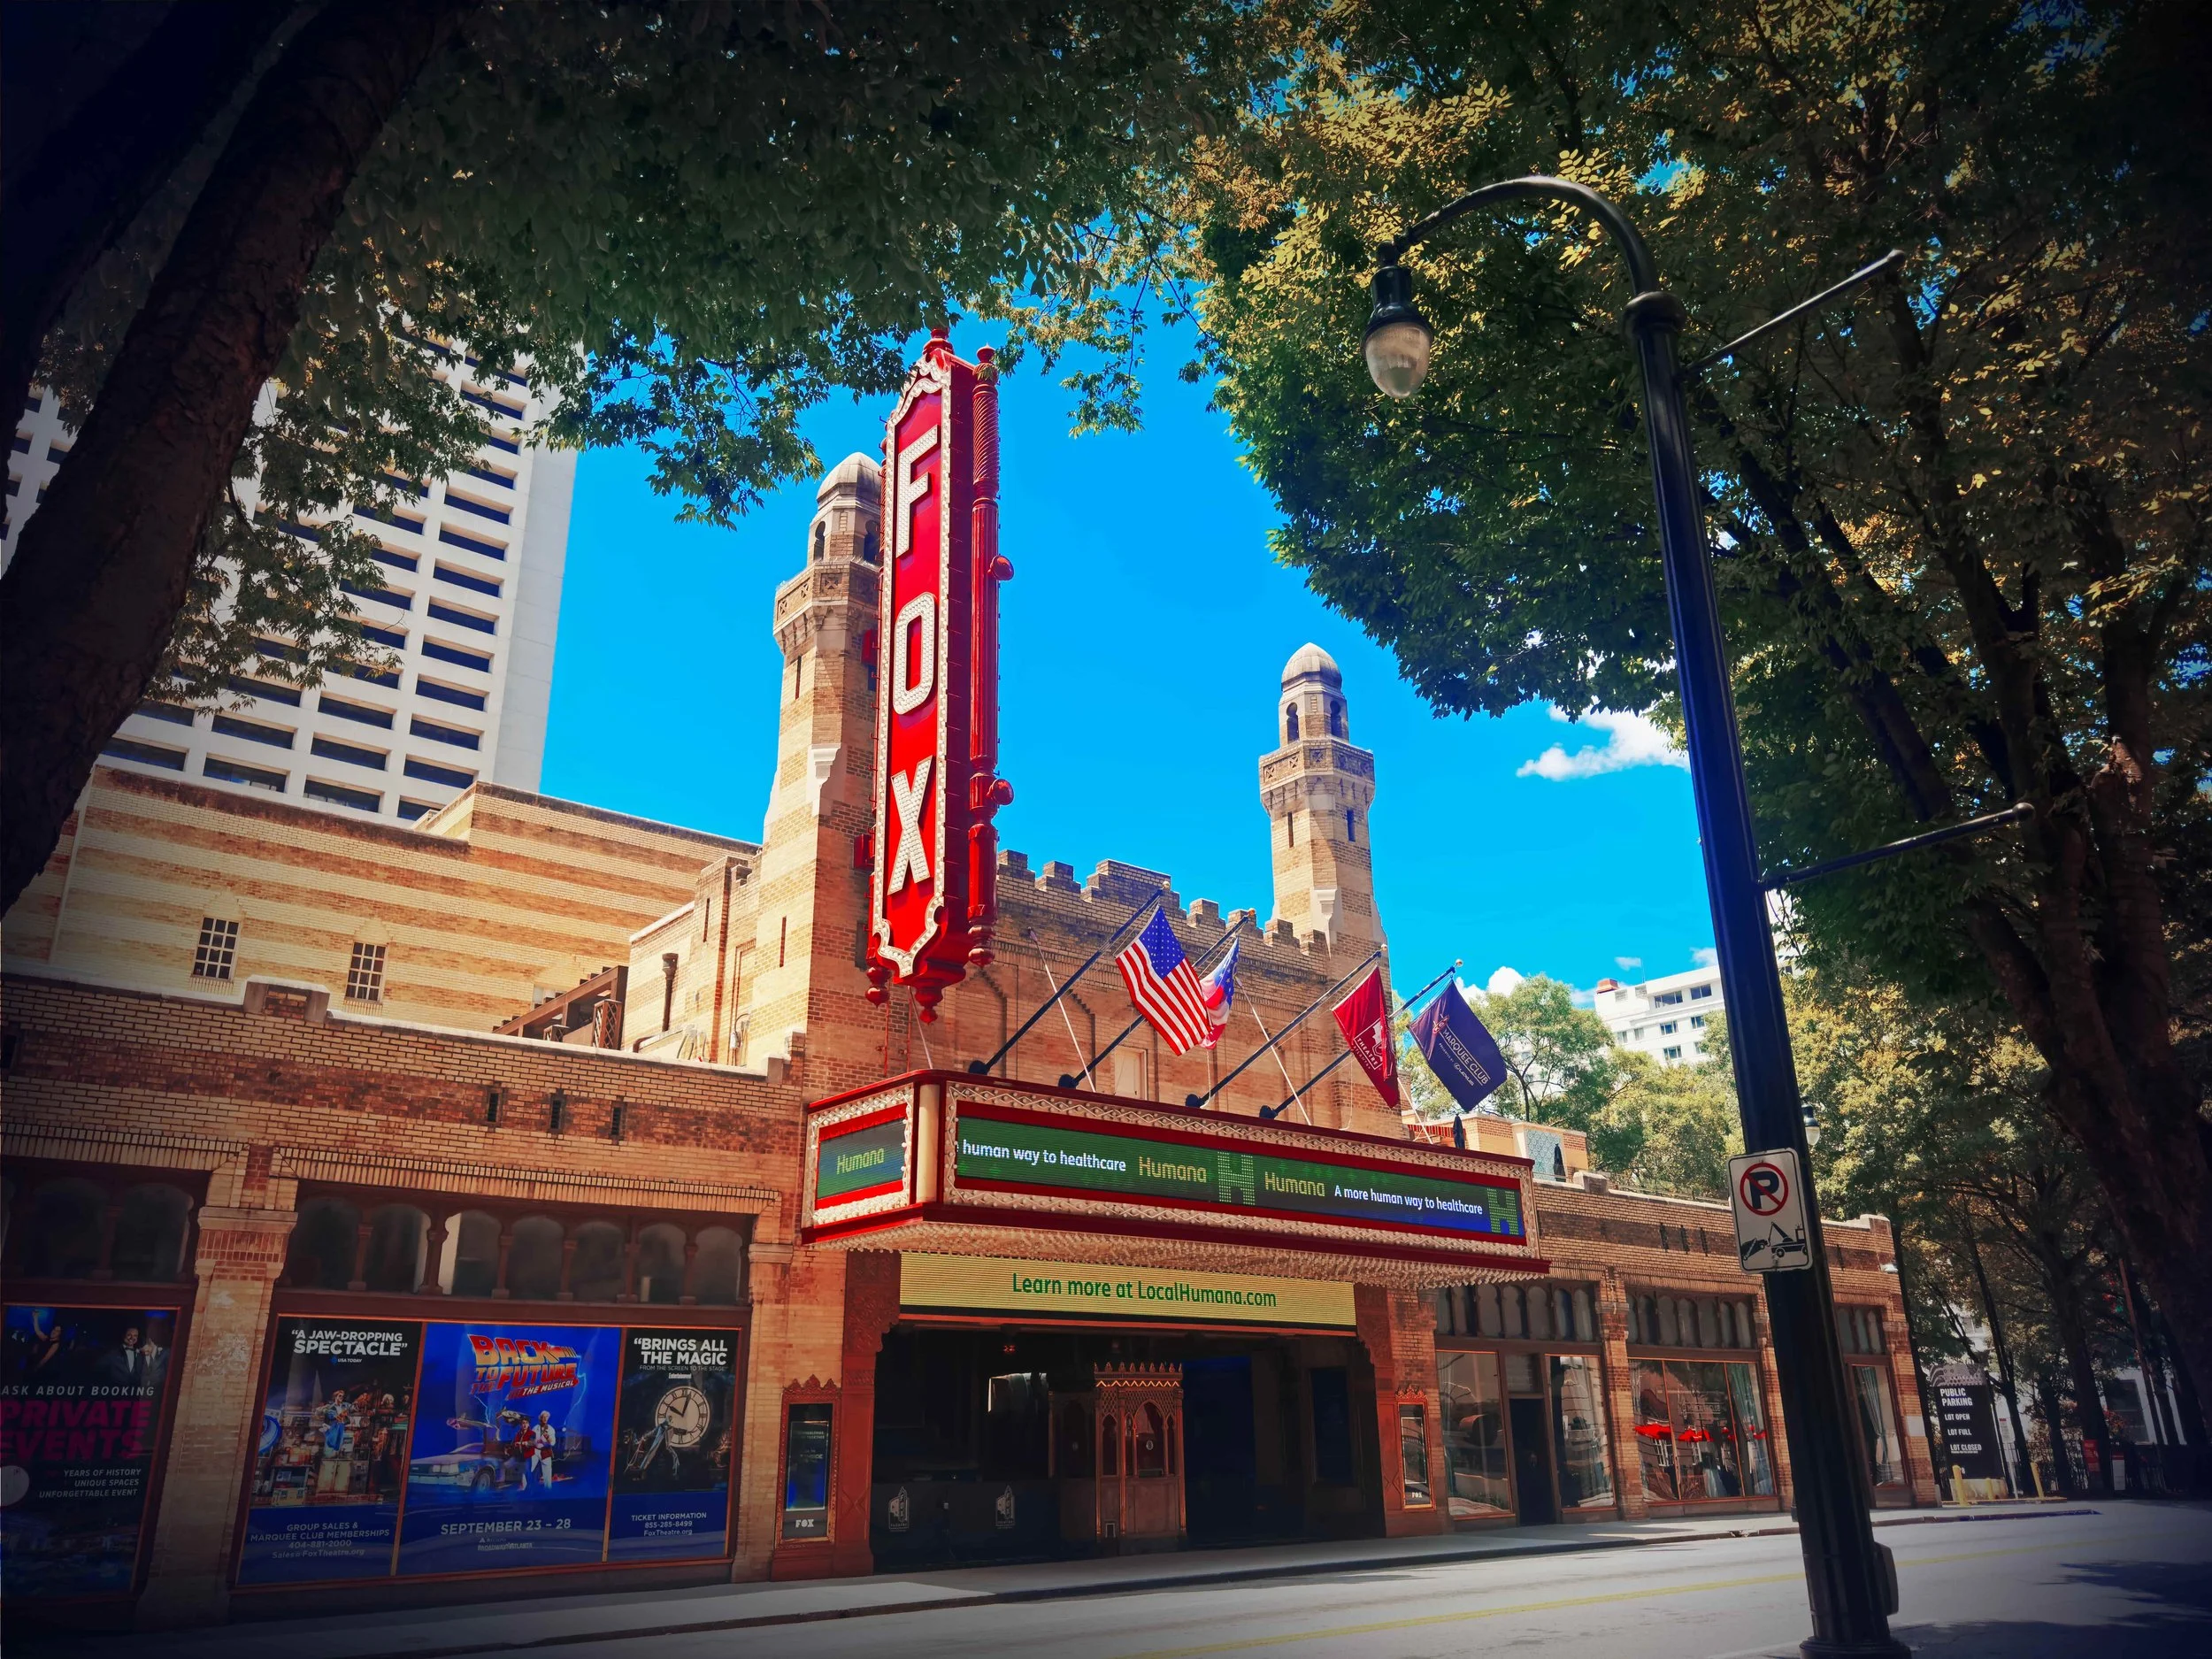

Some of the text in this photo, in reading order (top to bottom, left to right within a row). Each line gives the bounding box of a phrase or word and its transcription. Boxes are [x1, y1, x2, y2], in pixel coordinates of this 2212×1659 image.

[887, 424, 939, 895] FOX
[1357, 1038, 1378, 1064] THEATRE
[1442, 1028, 1489, 1085] MARQUEE CLUB
[836, 1148, 884, 1175] Humana
[963, 1139, 1009, 1159] human
[1013, 1146, 1039, 1166] way
[1043, 1149, 1056, 1164] to
[1060, 1150, 1126, 1172] healthcare
[1138, 1156, 1207, 1183] Humana
[1264, 1171, 1325, 1197] Humana
[1334, 1186, 1483, 1216] A more human way to healthcare
[1012, 1272, 1277, 1308] Learn more at LocalHumana.com
[308, 1331, 403, 1341] JAW-DROPPING
[700, 1340, 728, 1352] ALL
[467, 1334, 575, 1364] BACK
[641, 1351, 726, 1365] THE MAGIC
[475, 1366, 499, 1381] TO
[496, 1363, 578, 1391] FUTURE
[1, 1386, 155, 1396] ASK ABOUT BOOKING
[522, 1380, 574, 1396] THE MUSICAL
[1939, 1387, 1966, 1397] PUBLIC
[1941, 1397, 1973, 1406] PARKING
[0, 1399, 153, 1427] PRIVATE
[287, 1523, 319, 1532] GROUP
[321, 1522, 350, 1531] SALES
[441, 1521, 522, 1534] SEPTEMBER
[526, 1520, 541, 1531] 23
[556, 1518, 572, 1530] 28
[795, 1519, 814, 1528] FOX
[250, 1529, 390, 1541] MARQUEE CLUB MEMBERSHIPS
